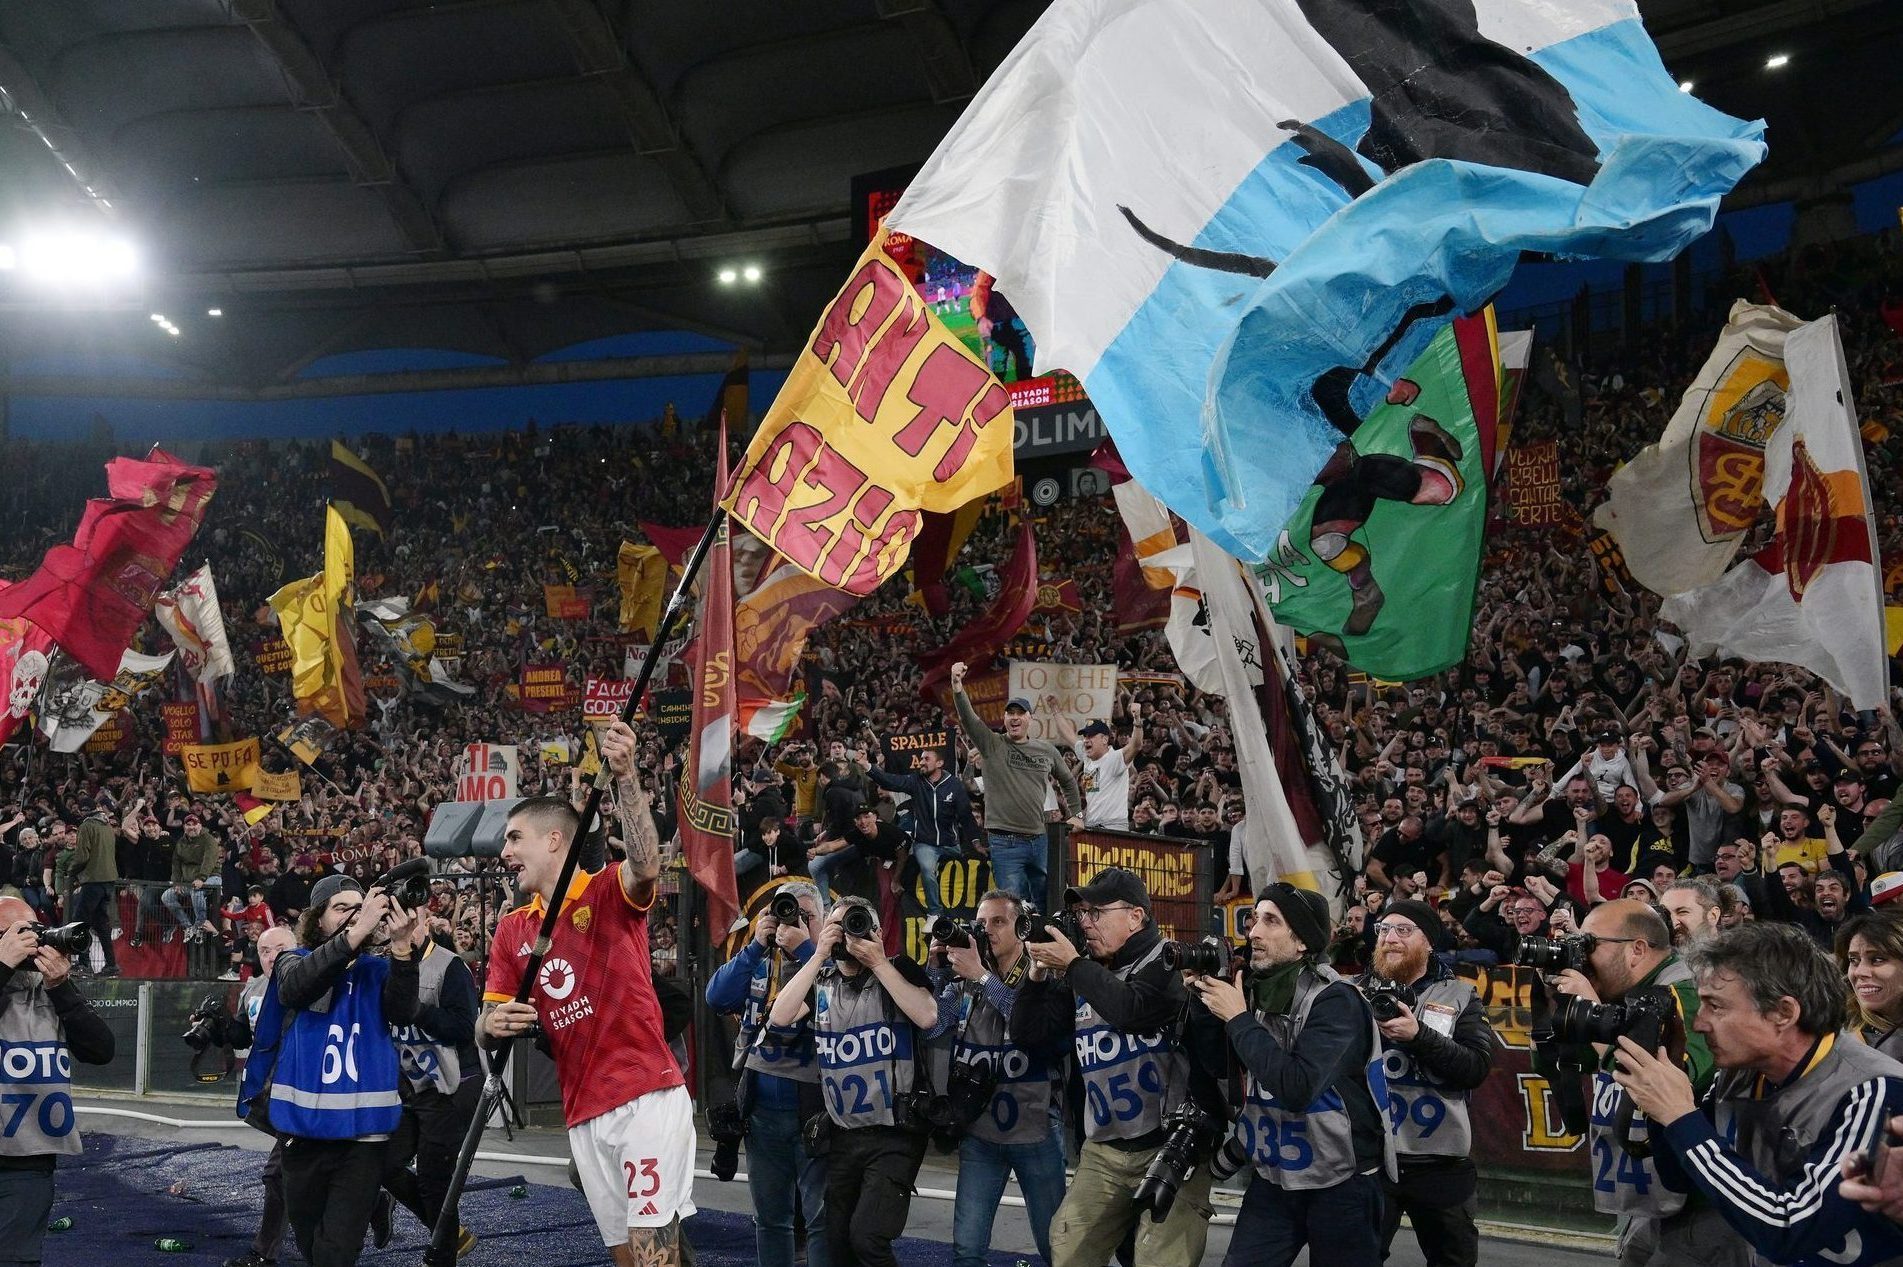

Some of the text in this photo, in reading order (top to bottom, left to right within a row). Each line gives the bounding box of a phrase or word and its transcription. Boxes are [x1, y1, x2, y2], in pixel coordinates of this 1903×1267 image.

[1011, 387, 1050, 400] RIYADH
[1011, 396, 1050, 408] SEASON
[1013, 409, 1108, 450] OLIM
[1509, 443, 1558, 467] VEDRAI
[1510, 463, 1559, 487] RIBELLI
[722, 421, 920, 597] AZiO
[255, 650, 291, 665] QUESTIO
[526, 670, 561, 682] ANDREA
[1020, 668, 1111, 690] IO CHE
[525, 684, 566, 698] PRESENTE
[164, 705, 196, 716] VOGLIO
[1032, 693, 1094, 714] AMO
[170, 719, 193, 729] SOLO
[172, 730, 194, 741] STAR
[890, 732, 947, 751] SPALLE
[188, 753, 208, 769] SE
[467, 743, 489, 772] TI
[457, 775, 506, 802] AMO
[549, 996, 590, 1020] RIYADH
[553, 1006, 594, 1030] SEASON
[815, 1026, 896, 1064] PHOTO
[825, 1069, 893, 1117] 021
[1234, 1112, 1314, 1171] 035
[623, 1157, 661, 1199] 23
